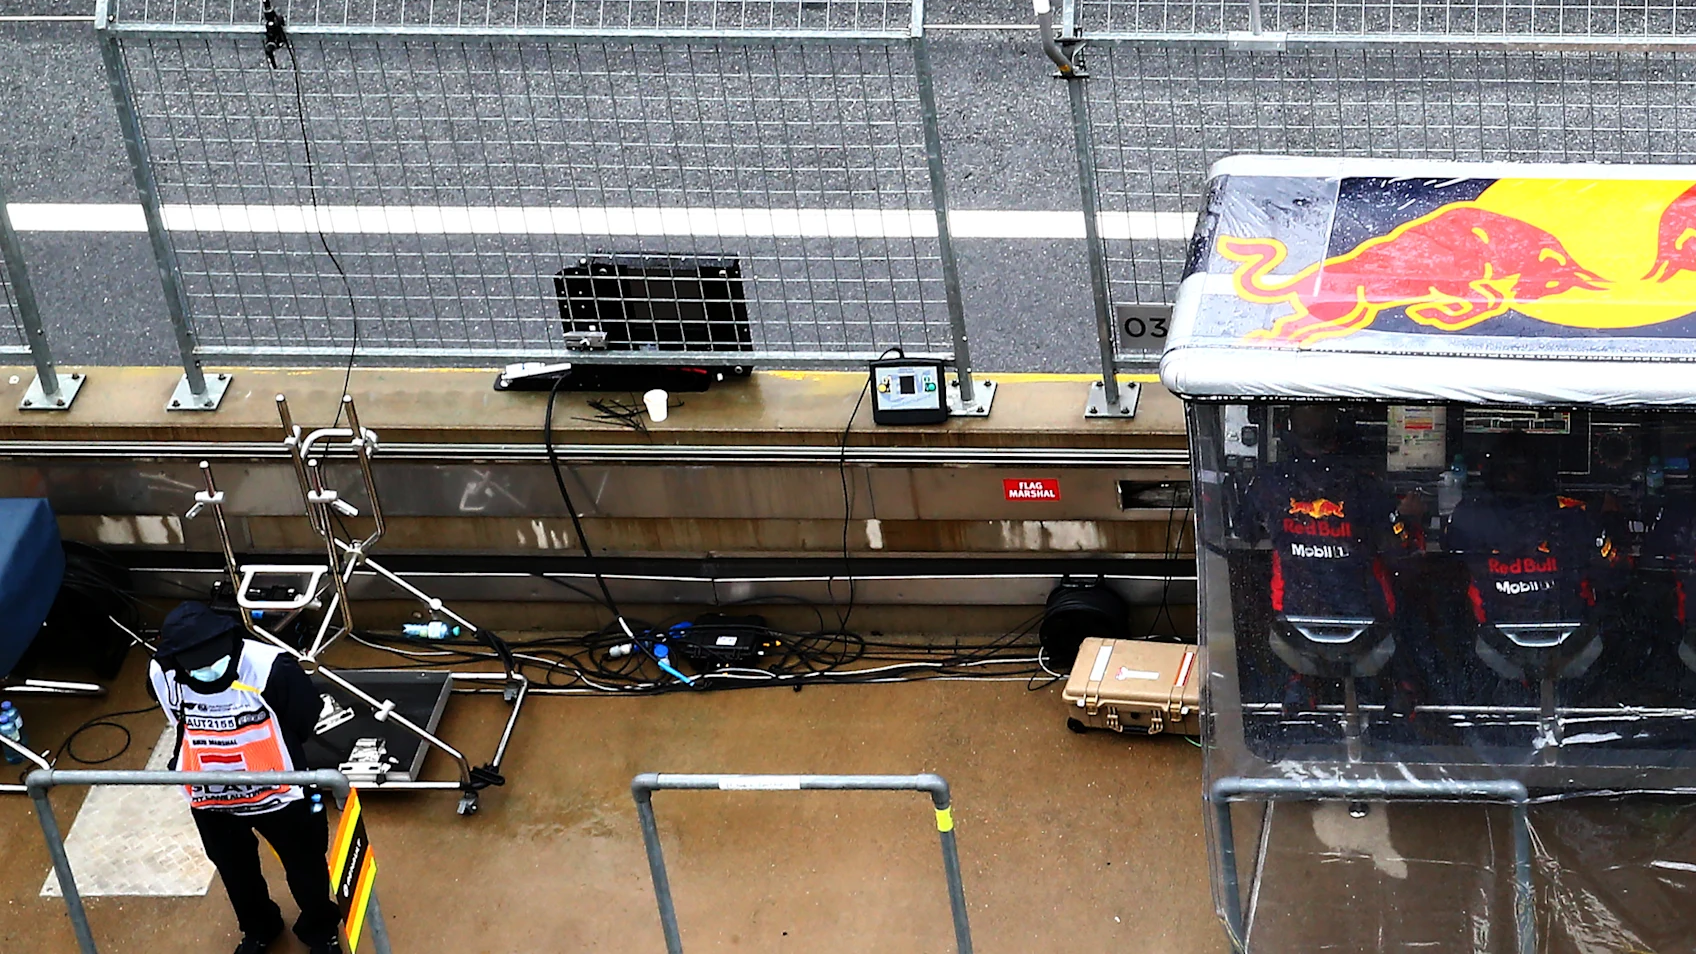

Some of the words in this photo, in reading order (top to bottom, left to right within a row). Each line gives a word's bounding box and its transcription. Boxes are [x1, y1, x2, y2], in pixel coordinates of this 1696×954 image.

[1124, 317, 1169, 338] 03
[1018, 481, 1043, 490] FLAG
[1009, 489, 1056, 498] MARSHAL
[1283, 518, 1317, 535] Red
[1318, 521, 1352, 537] Bull
[1291, 543, 1333, 558] Mobil
[1488, 557, 1522, 574] Red
[1523, 557, 1557, 573] Bull
[1496, 581, 1539, 595] Mobil
